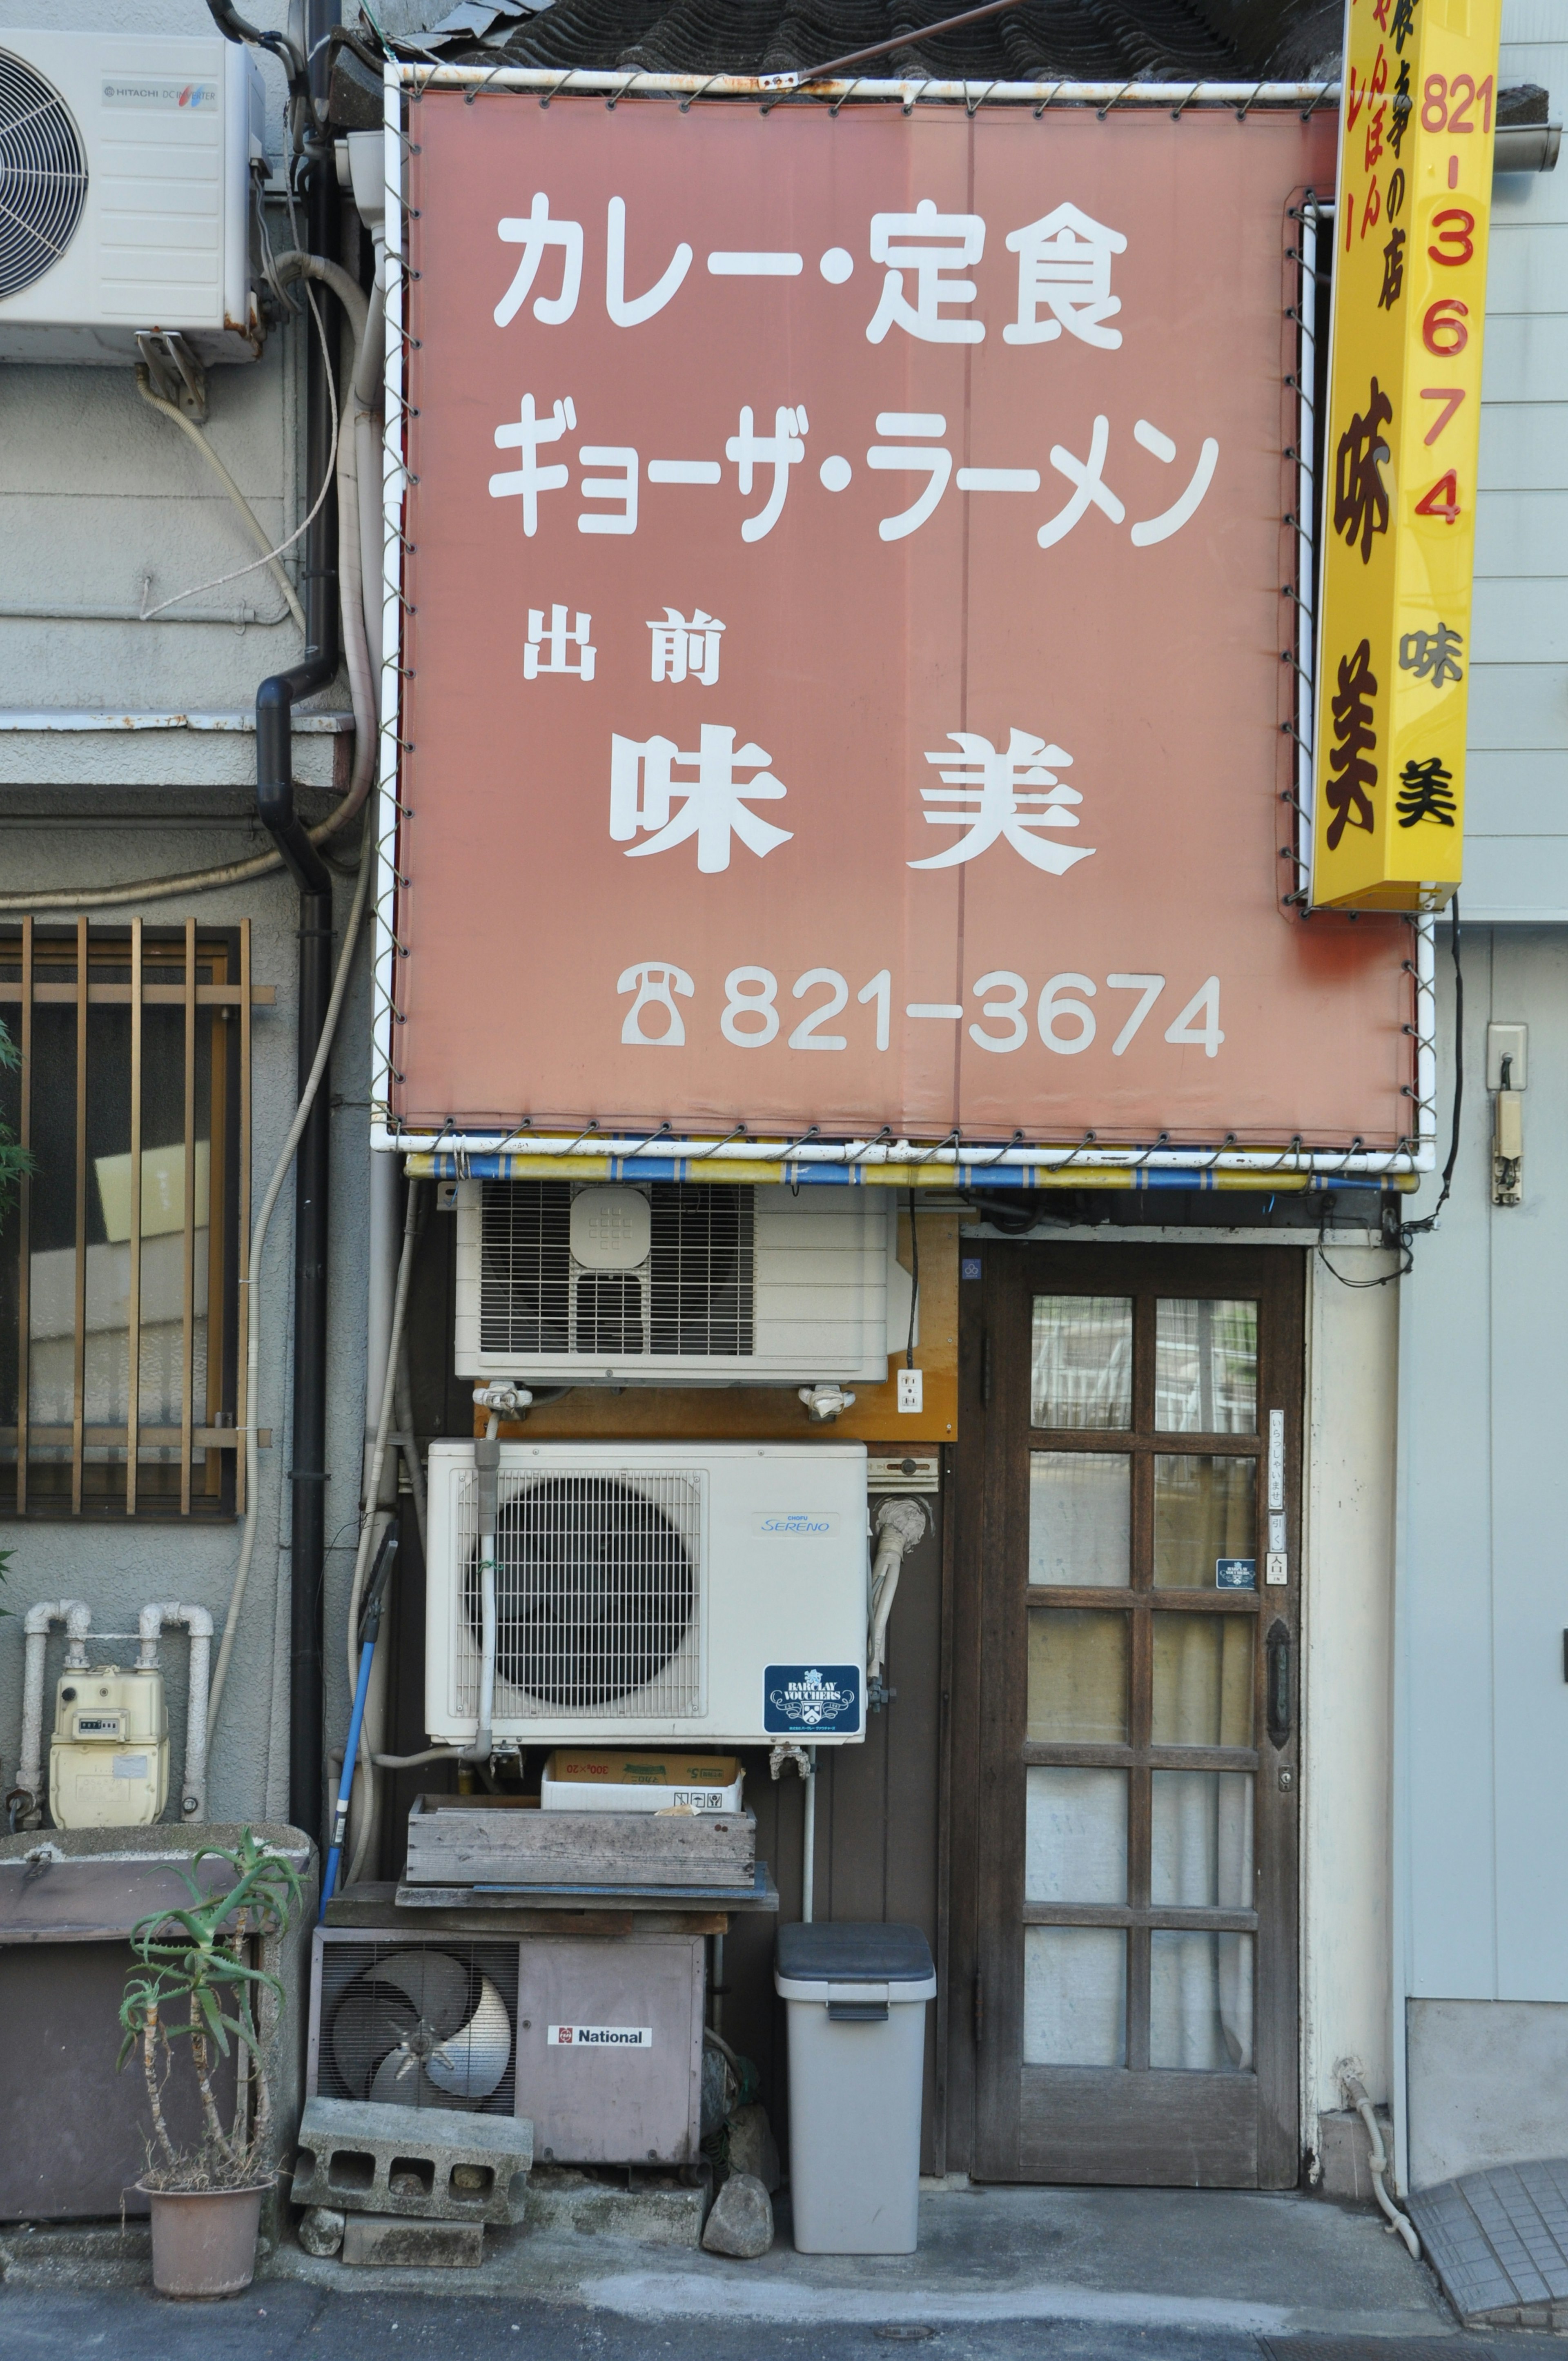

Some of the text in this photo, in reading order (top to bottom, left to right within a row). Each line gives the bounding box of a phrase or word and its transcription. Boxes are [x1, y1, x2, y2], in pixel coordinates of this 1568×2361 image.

[117, 89, 216, 101] HITACHI DC INVERTER
[494, 192, 1127, 349] カレー・定食
[489, 393, 1219, 549] ギョーザ・ラーメン
[721, 966, 1225, 1058] 821-3674
[1272, 1419, 1281, 1500] いらっしゃいませ
[761, 1519, 830, 1533] SERENO
[1272, 1519, 1281, 1544] 引く
[1271, 1555, 1282, 1573] 入口
[784, 1691, 841, 1700] VOUCHERS
[788, 1682, 837, 1691] BARCLAY
[579, 2029, 643, 2044] National
